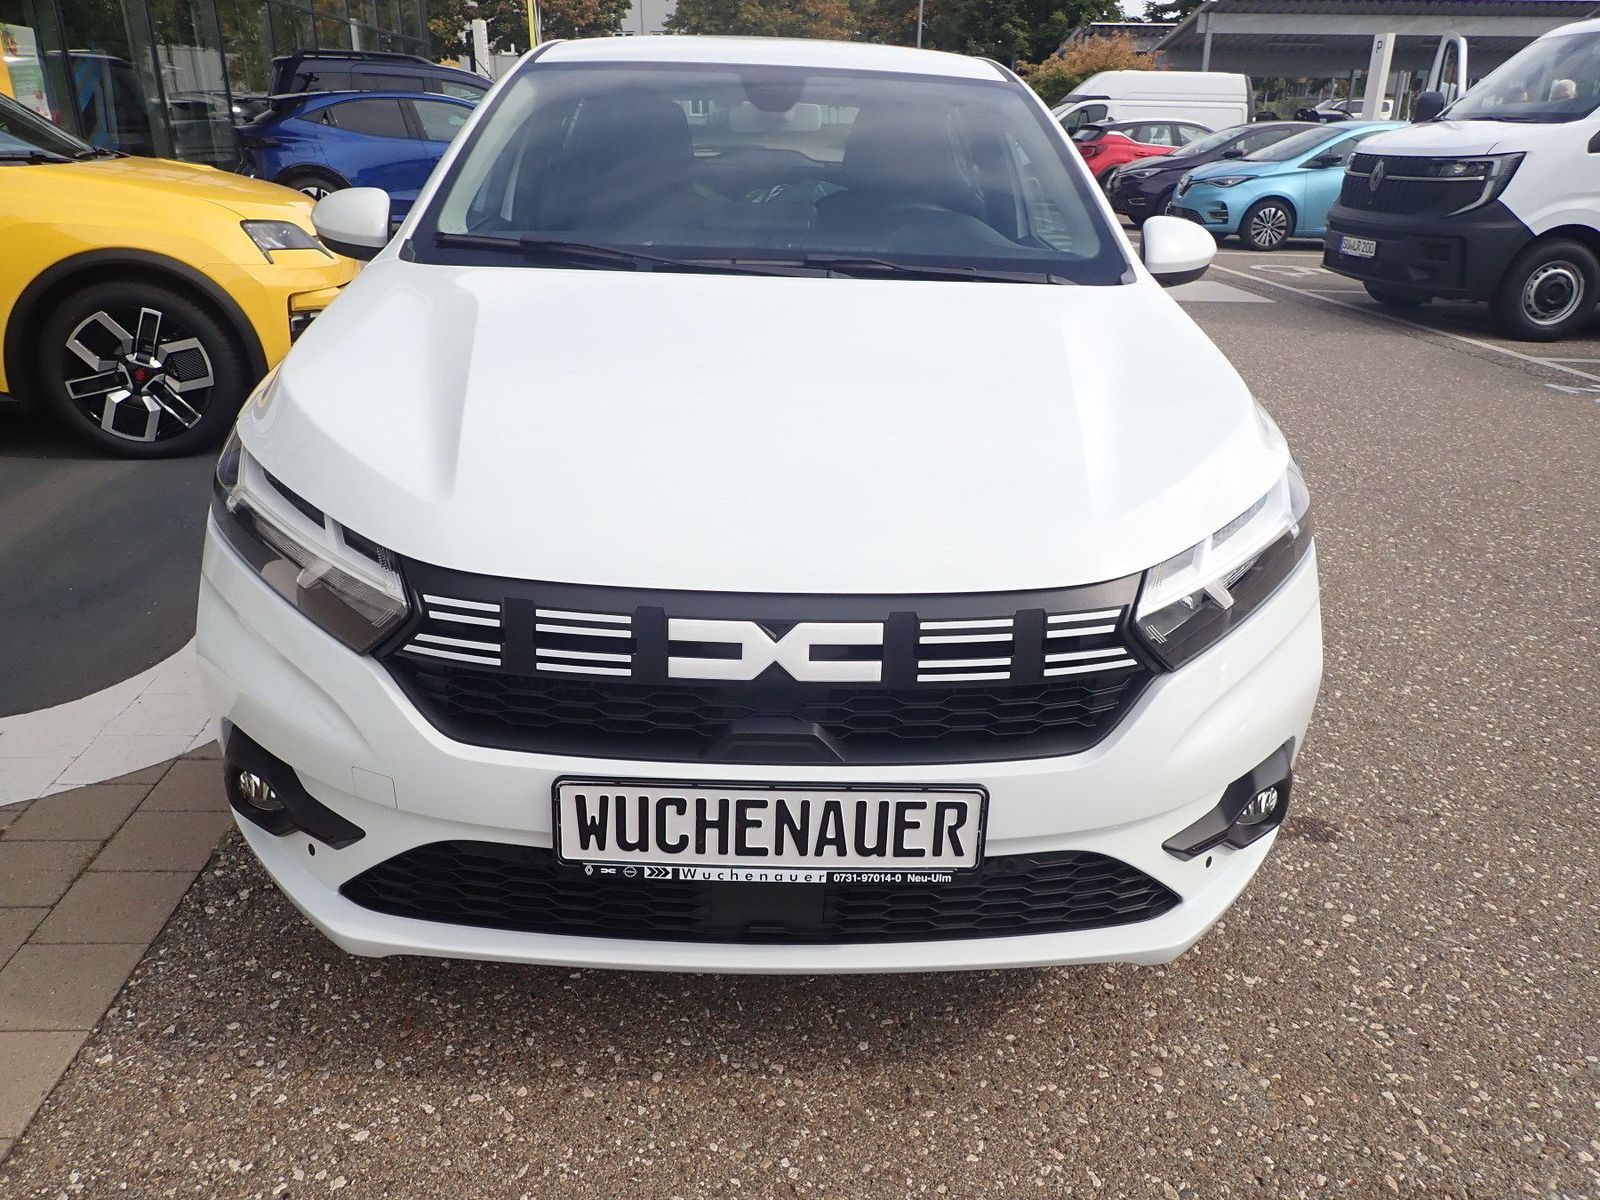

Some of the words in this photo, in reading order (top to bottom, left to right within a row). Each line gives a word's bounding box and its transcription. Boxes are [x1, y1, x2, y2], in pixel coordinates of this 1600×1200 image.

[1375, 40, 1383, 54] P
[1361, 241, 1375, 254] 200
[574, 794, 968, 858] WUCHENAUER
[681, 868, 825, 882] Wuchenauer
[833, 873, 902, 883] 0731-97014-0
[907, 873, 952, 883] Neu-Ulm
